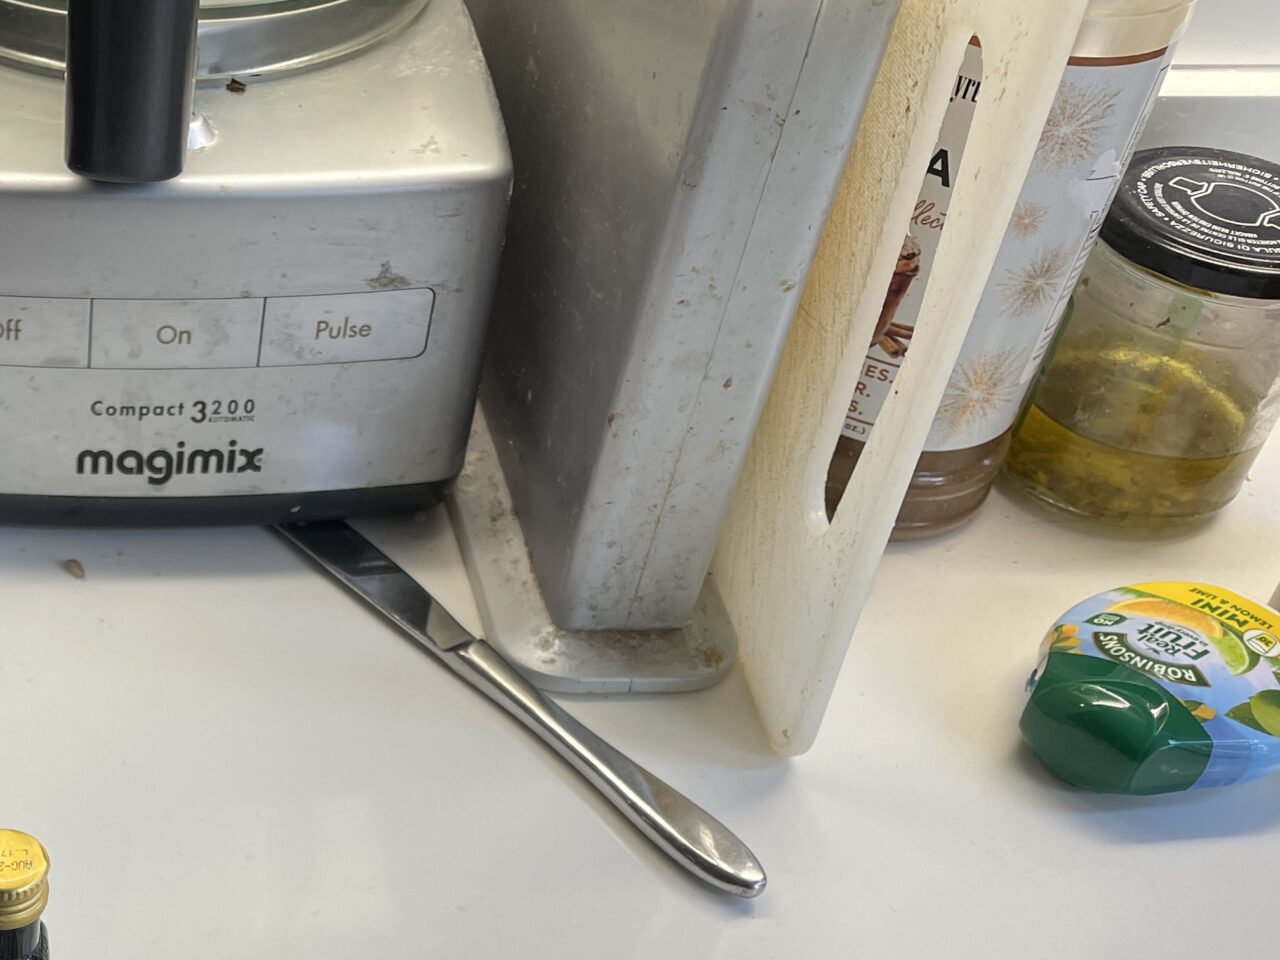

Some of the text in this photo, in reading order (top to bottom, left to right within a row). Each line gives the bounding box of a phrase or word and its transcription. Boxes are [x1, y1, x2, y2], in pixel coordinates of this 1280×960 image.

[156, 325, 192, 346] On
[315, 319, 372, 341] Pulse
[91, 399, 256, 424] Compact 3200
[77, 440, 264, 486] magimix
[1189, 587, 1273, 630] LEMON LIME
[1190, 598, 1250, 628] MINI
[1099, 632, 1197, 682] ROBINSONS
[1136, 623, 1211, 661] Fruit
[1137, 634, 1177, 658] Real
